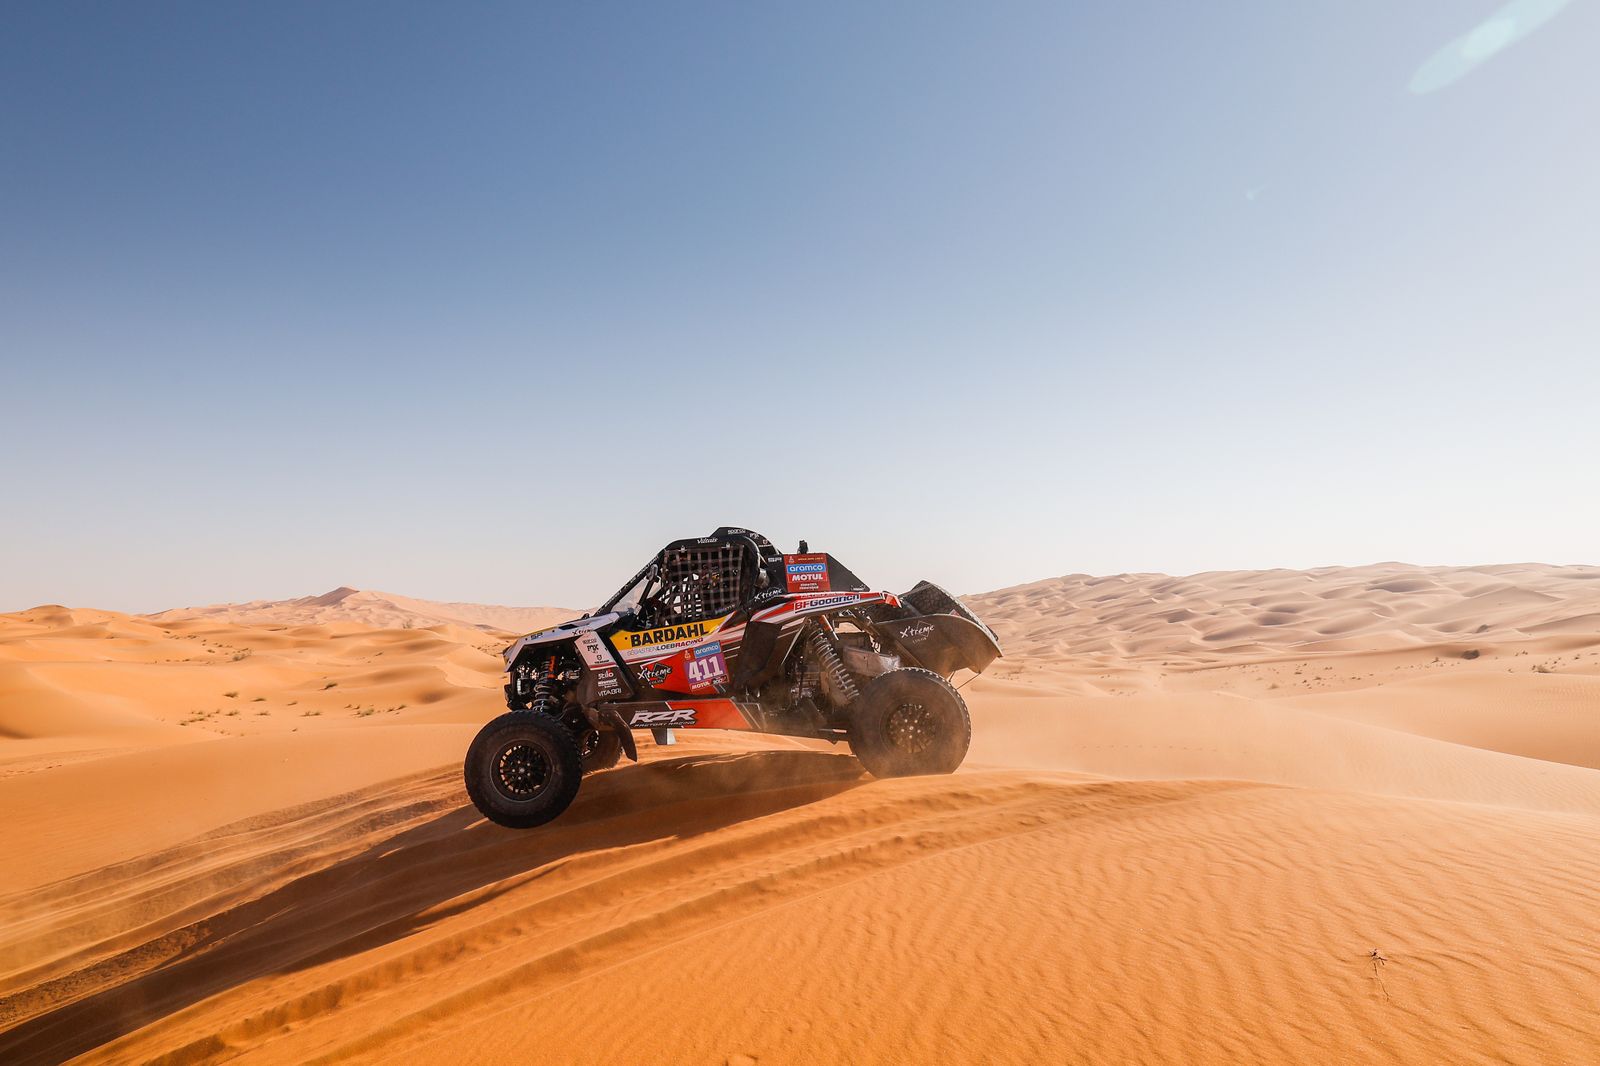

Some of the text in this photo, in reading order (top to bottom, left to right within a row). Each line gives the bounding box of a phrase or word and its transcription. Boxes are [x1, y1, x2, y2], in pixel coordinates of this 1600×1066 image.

[789, 564, 823, 572] aramco
[792, 573, 823, 582] MOTUL
[794, 594, 860, 611] BFGoodrich
[630, 623, 709, 648] BARDAHL
[695, 645, 719, 655] aramco
[688, 656, 724, 681] 411
[691, 681, 710, 690] MOTUL
[629, 709, 696, 725] RZR
